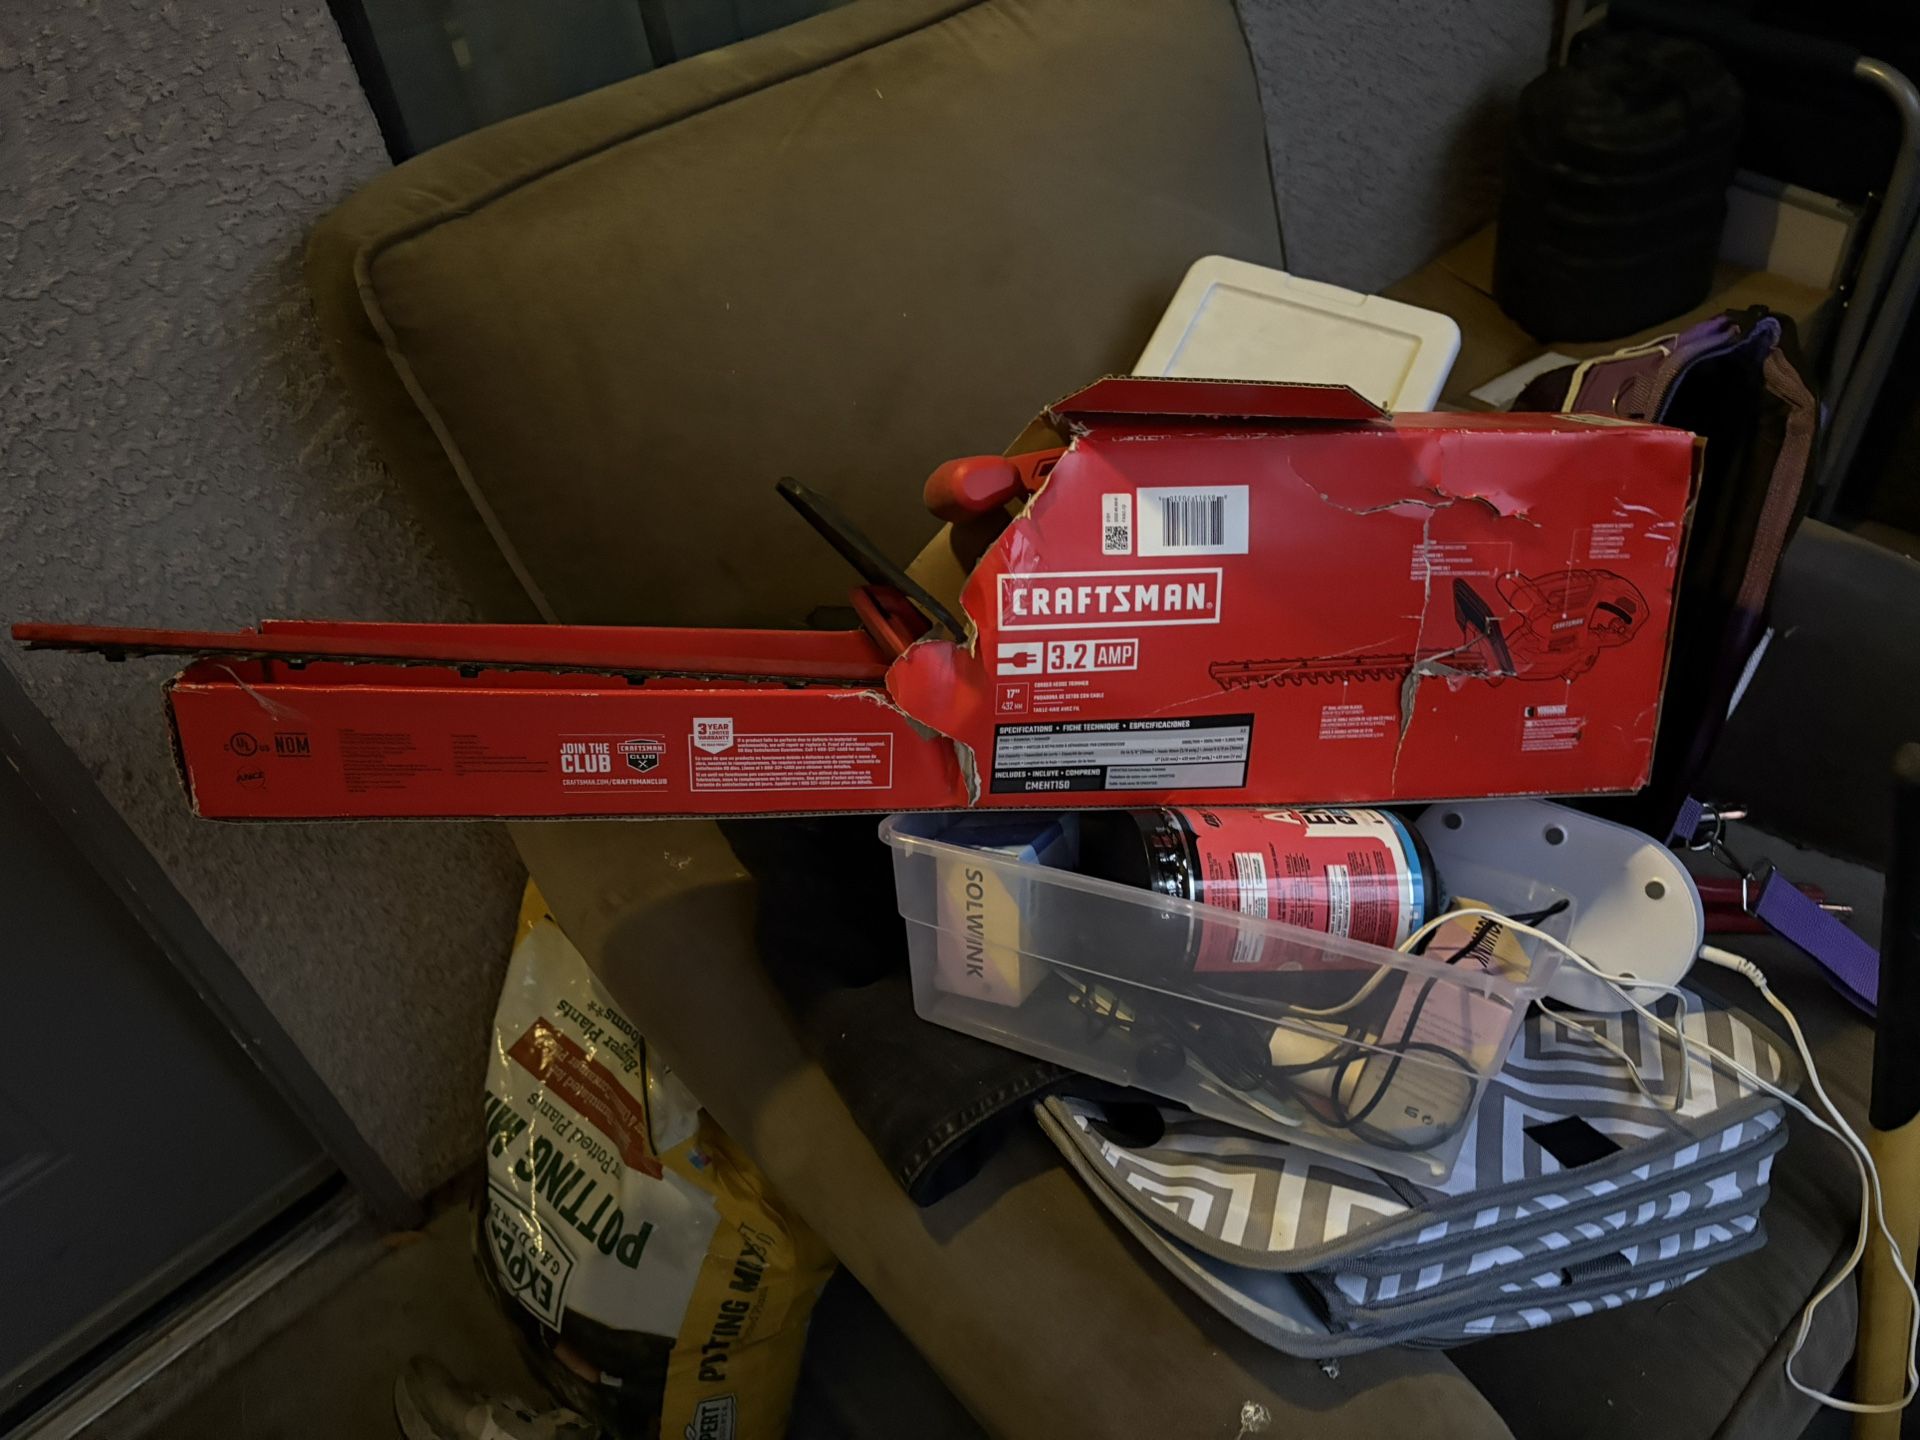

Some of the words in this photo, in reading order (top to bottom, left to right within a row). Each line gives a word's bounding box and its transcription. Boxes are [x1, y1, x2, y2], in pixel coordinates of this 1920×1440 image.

[1051, 644, 1087, 669] 3.2
[1098, 646, 1132, 664] AMP
[698, 723, 707, 734] 3
[1000, 725, 1053, 734] SPECIFICATIONS
[1084, 723, 1120, 731] TECHNIQUE
[1129, 720, 1191, 729] ESPECIFICACIONES
[274, 736, 310, 753] NOM
[560, 743, 586, 754] JOIN
[588, 743, 610, 753] THE
[561, 754, 611, 773] CLUB
[563, 778, 668, 786] CRAFTSMAN.COM/CRAFTSMANCLUB
[995, 771, 1026, 779] INCLUDES
[1025, 780, 1070, 790] CMEHT150
[557, 999, 604, 1043] Plants
[603, 1033, 639, 1074] Bigger
[527, 1091, 572, 1138] Plants
[567, 1128, 615, 1174] Potted
[515, 1134, 654, 1269] POTTING
